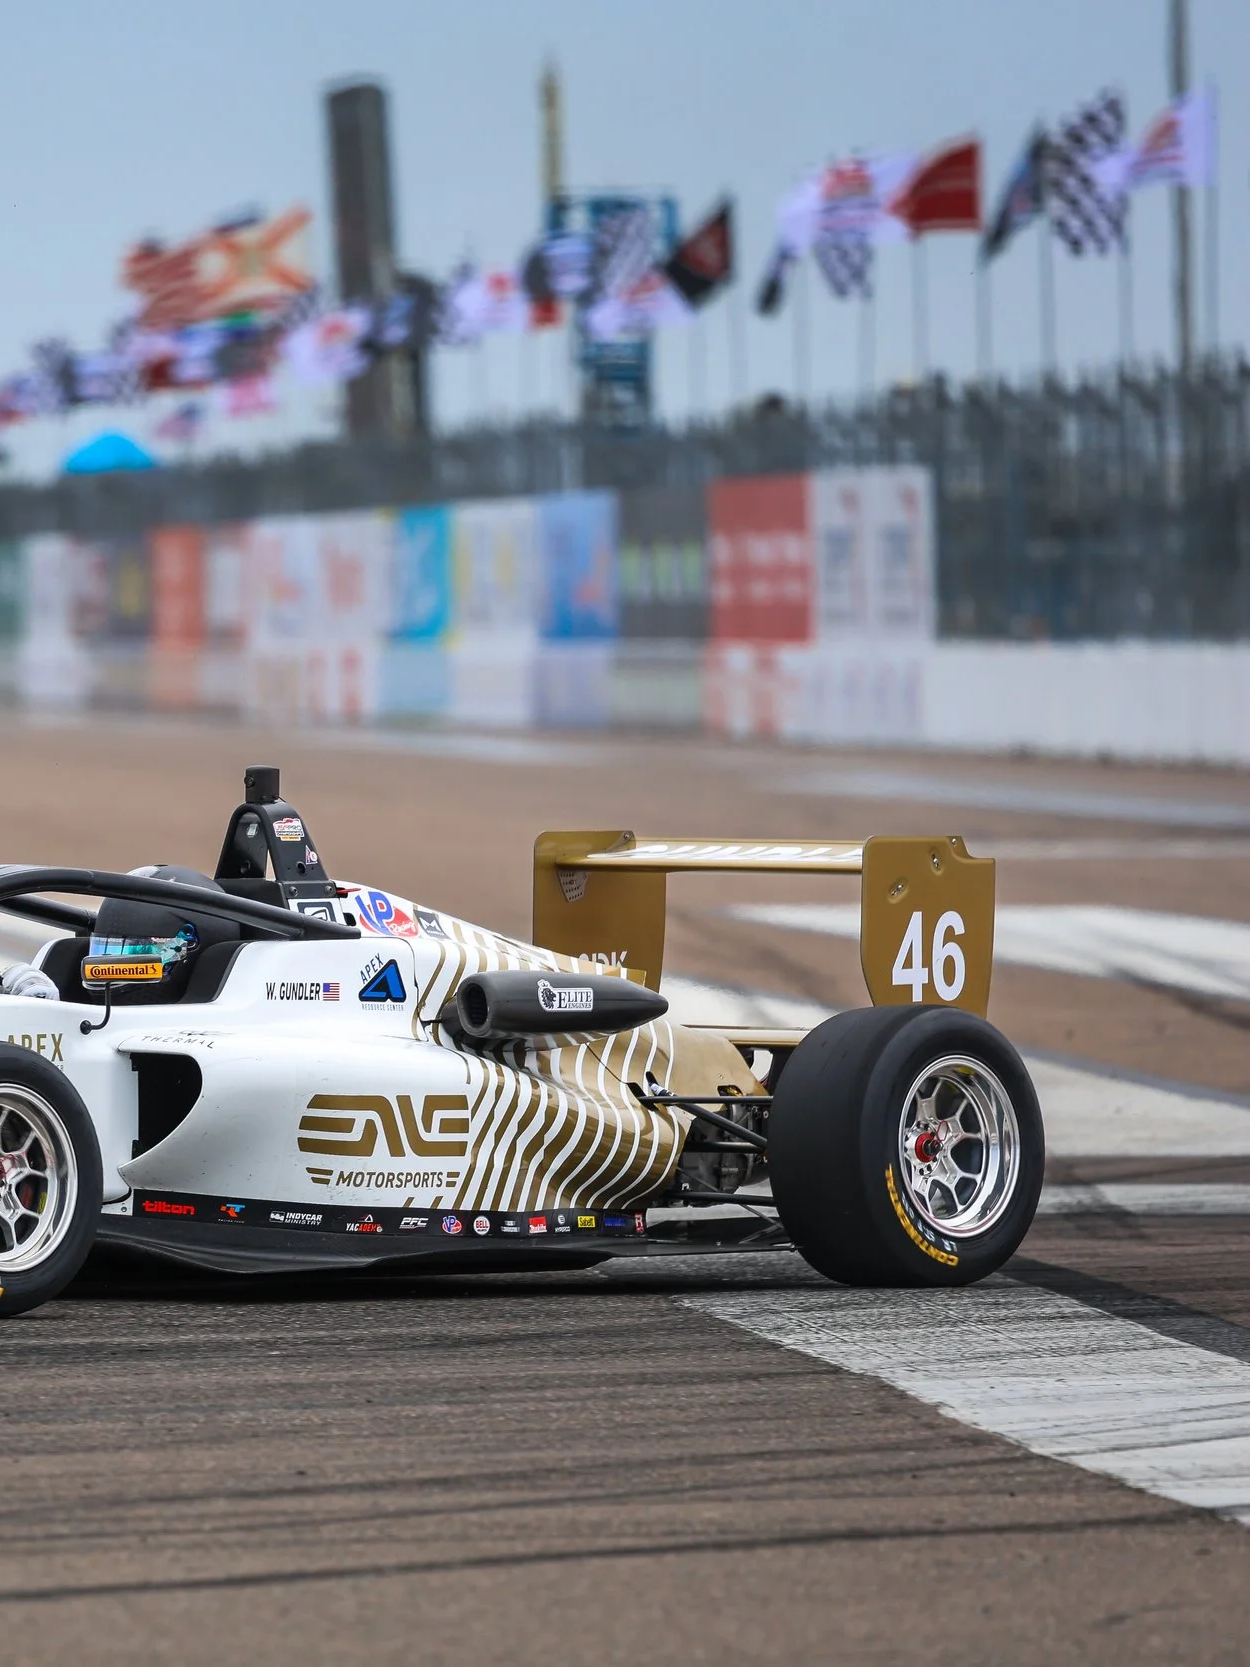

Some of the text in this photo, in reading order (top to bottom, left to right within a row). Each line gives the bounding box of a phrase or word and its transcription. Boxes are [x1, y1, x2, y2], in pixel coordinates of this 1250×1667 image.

[355, 891, 394, 937] VP
[892, 910, 966, 1003] 46
[90, 965, 149, 978] Continental
[359, 952, 384, 984] APEX
[265, 982, 321, 1001] W. GUNDLER
[361, 1003, 386, 1011] RESOURCE
[556, 991, 592, 1009] ELITE
[335, 1170, 444, 1188] MOTORSPORTS
[142, 1201, 195, 1216] tilton
[285, 1212, 323, 1221] INDYCAR
[400, 1217, 429, 1226] PFC
[475, 1219, 489, 1229] BELL
